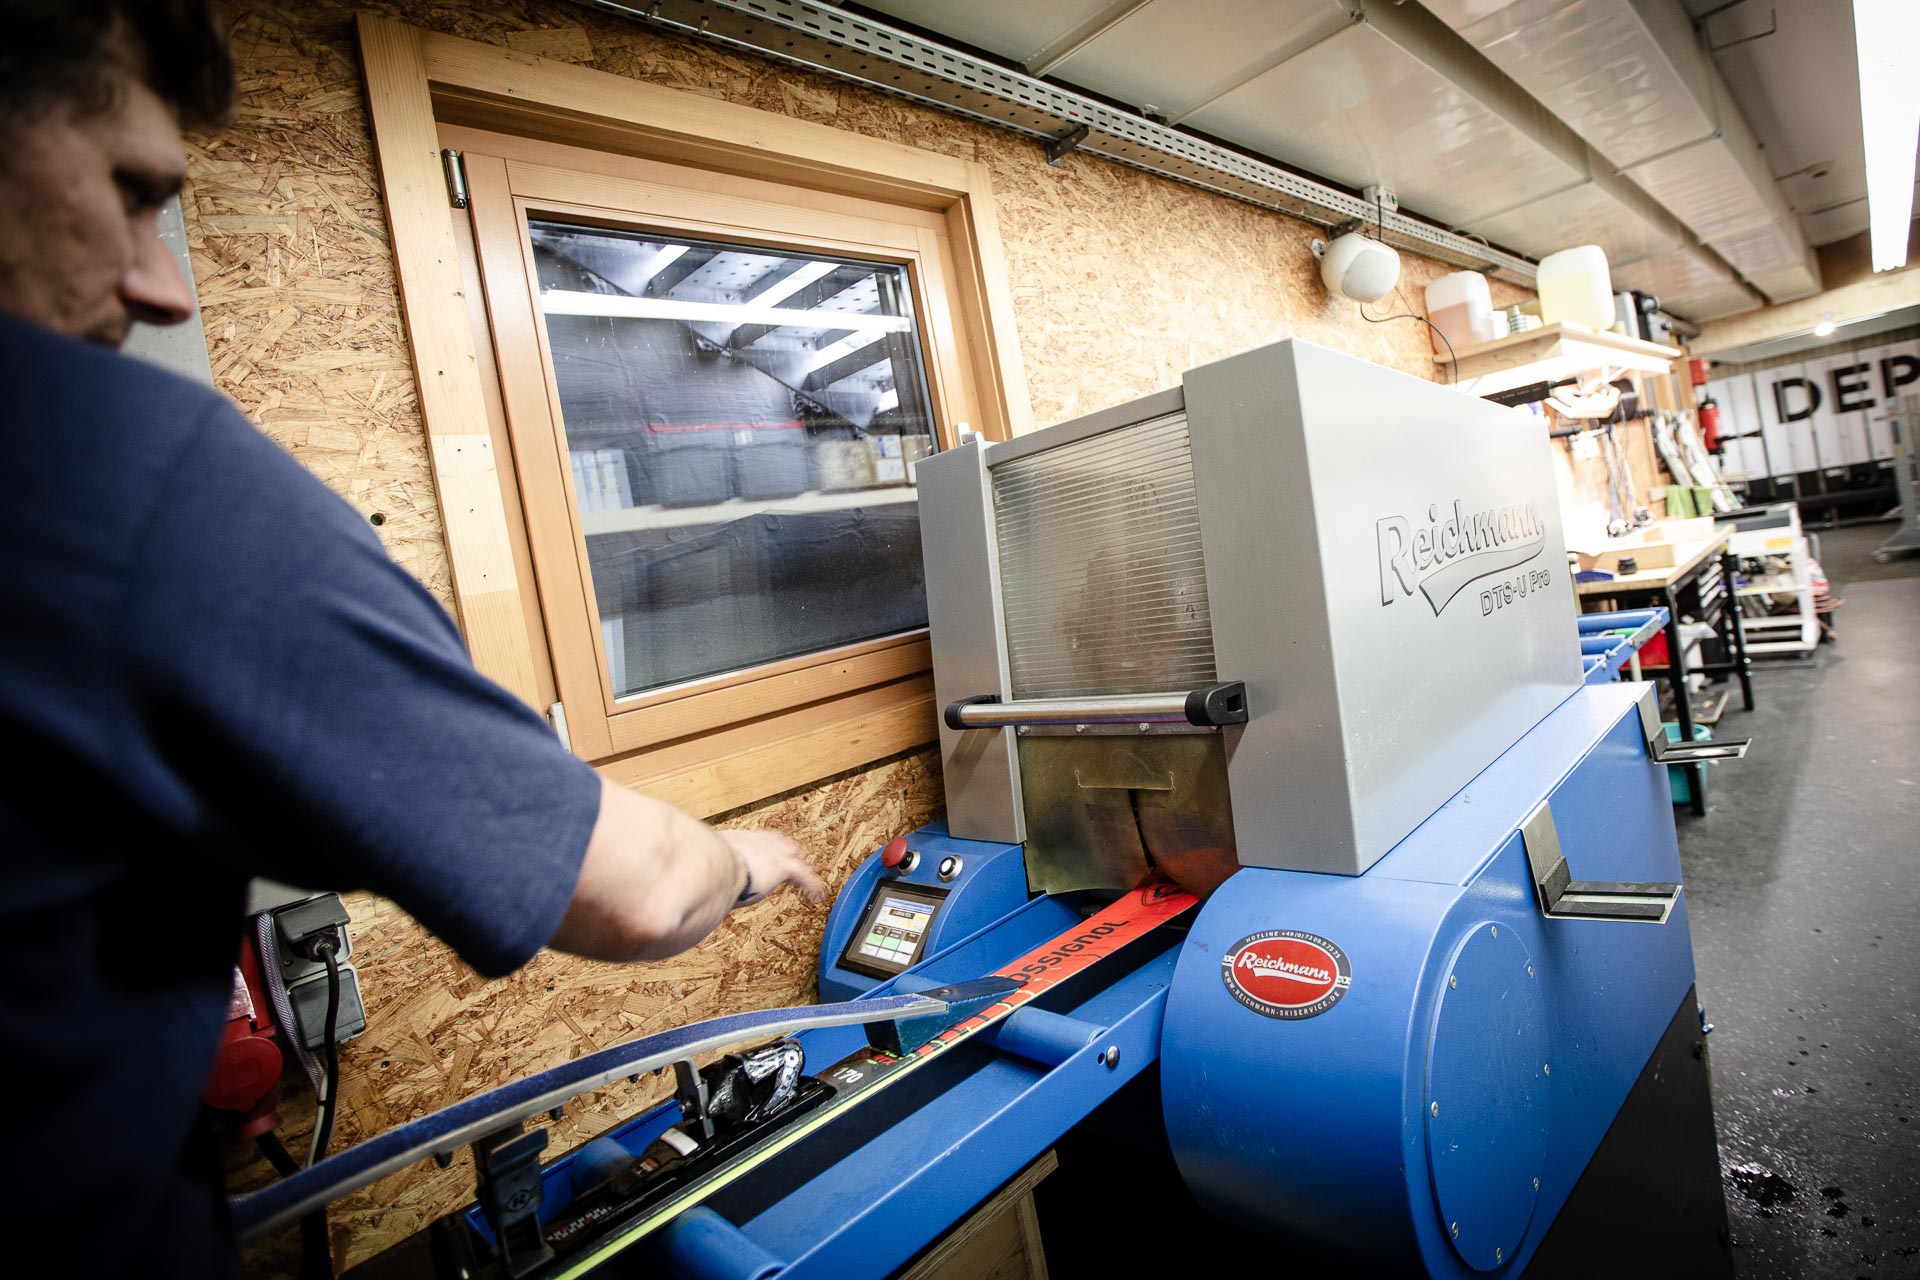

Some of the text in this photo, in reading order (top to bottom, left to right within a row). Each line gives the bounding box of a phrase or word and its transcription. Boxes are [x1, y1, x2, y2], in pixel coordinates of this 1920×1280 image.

[1772, 355, 1920, 424] DEP
[1376, 499, 1544, 606] Reichmann
[1480, 568, 1551, 616] DTS-U Pro
[1010, 920, 1130, 982] OSSIGNOL
[1245, 931, 1279, 944] HOTLINE
[1237, 951, 1331, 982] Reichmann
[832, 1067, 864, 1084] 170
